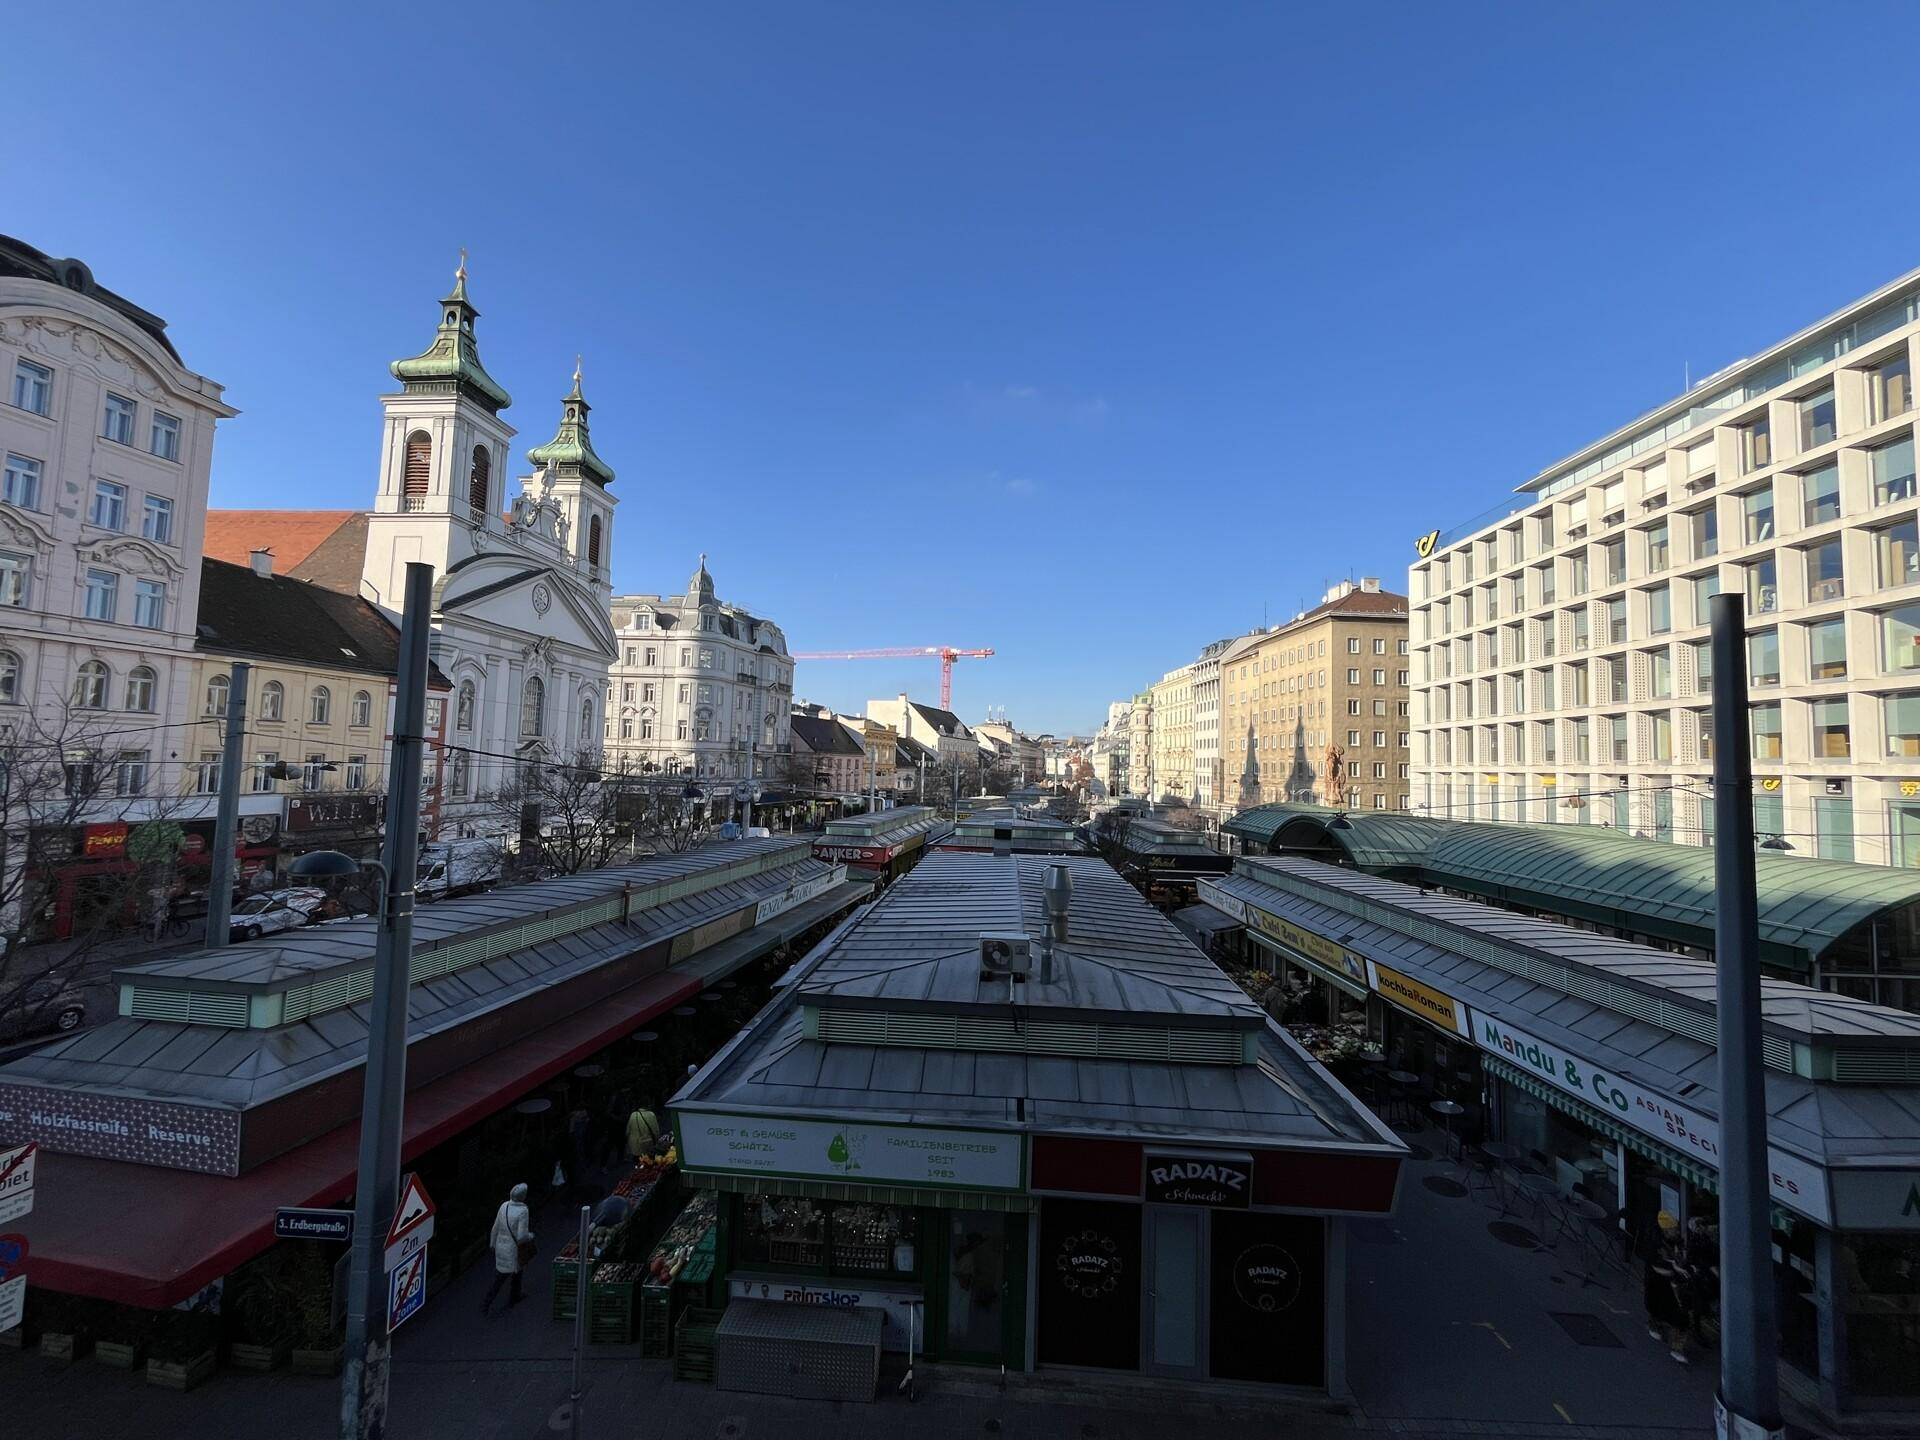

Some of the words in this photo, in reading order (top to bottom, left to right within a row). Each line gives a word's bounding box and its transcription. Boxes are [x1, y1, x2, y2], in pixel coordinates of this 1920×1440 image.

[819, 847, 862, 860] ANKER
[1378, 971, 1452, 1018] kochbaRoman
[1485, 1020, 1556, 1076] Mandu
[1565, 1059, 1583, 1090] &
[1592, 1073, 1629, 1112] Co
[1636, 1095, 1685, 1127] ASIAN
[31, 1110, 129, 1136] Holzfassreife
[148, 1124, 212, 1146] Reserve
[706, 1127, 736, 1137] OBST
[887, 1138, 998, 1154] FAMILIENBETRIEB
[927, 1155, 957, 1165] SEIT
[1150, 1162, 1248, 1191] RADATZ
[278, 1218, 288, 1229] 3.
[290, 1218, 346, 1233] Erdbergstraße
[401, 1236, 419, 1256] 2m
[1071, 1255, 1109, 1268] RADATZ
[1247, 1265, 1288, 1279] RADATZ
